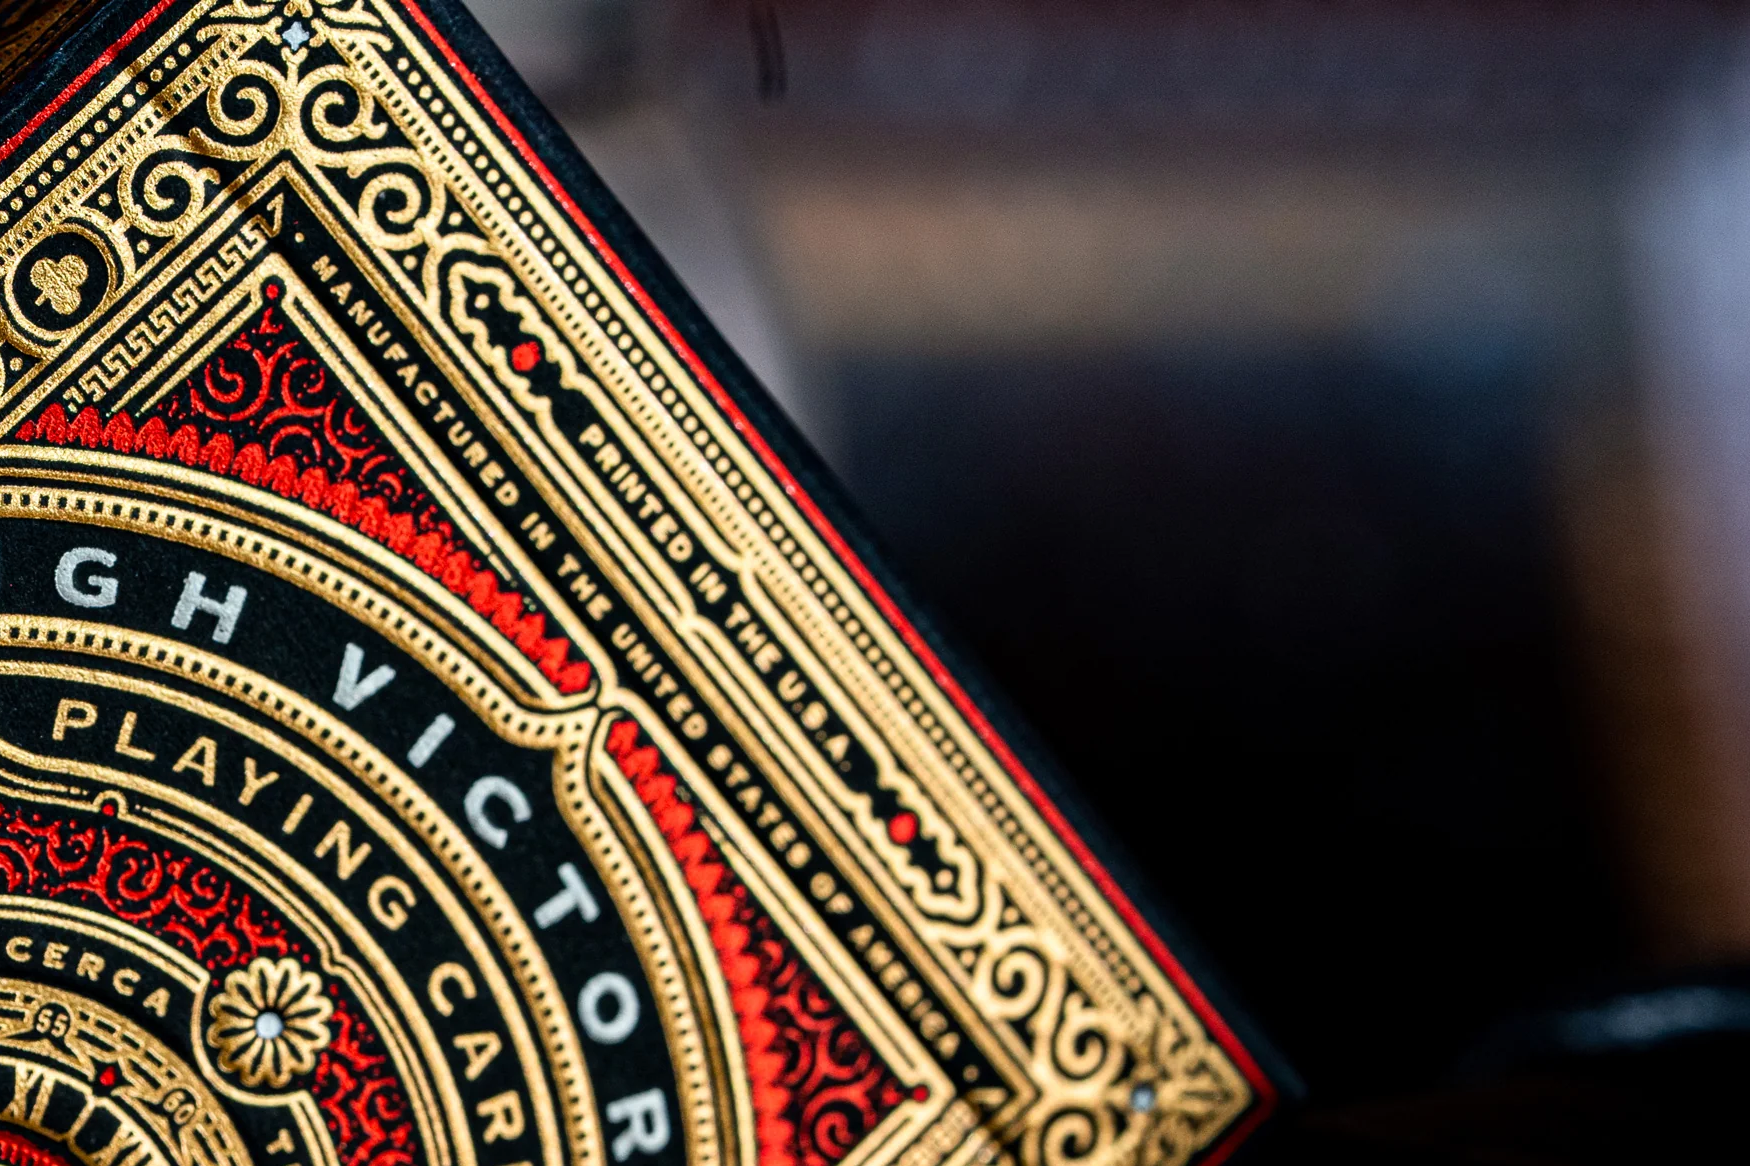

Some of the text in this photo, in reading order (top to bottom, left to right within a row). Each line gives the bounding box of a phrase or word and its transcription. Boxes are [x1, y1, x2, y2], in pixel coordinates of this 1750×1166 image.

[579, 424, 692, 561] PRINTED
[690, 563, 726, 603] IN
[726, 603, 782, 672] THE
[312, 255, 958, 1056] MANUFACTURED IN THE UNITED STATES OF AMERICA
[52, 699, 415, 930] PLAYING
[6, 937, 170, 1017] CERCA
[37, 1011, 68, 1037] 55
[164, 1093, 196, 1124] 60
